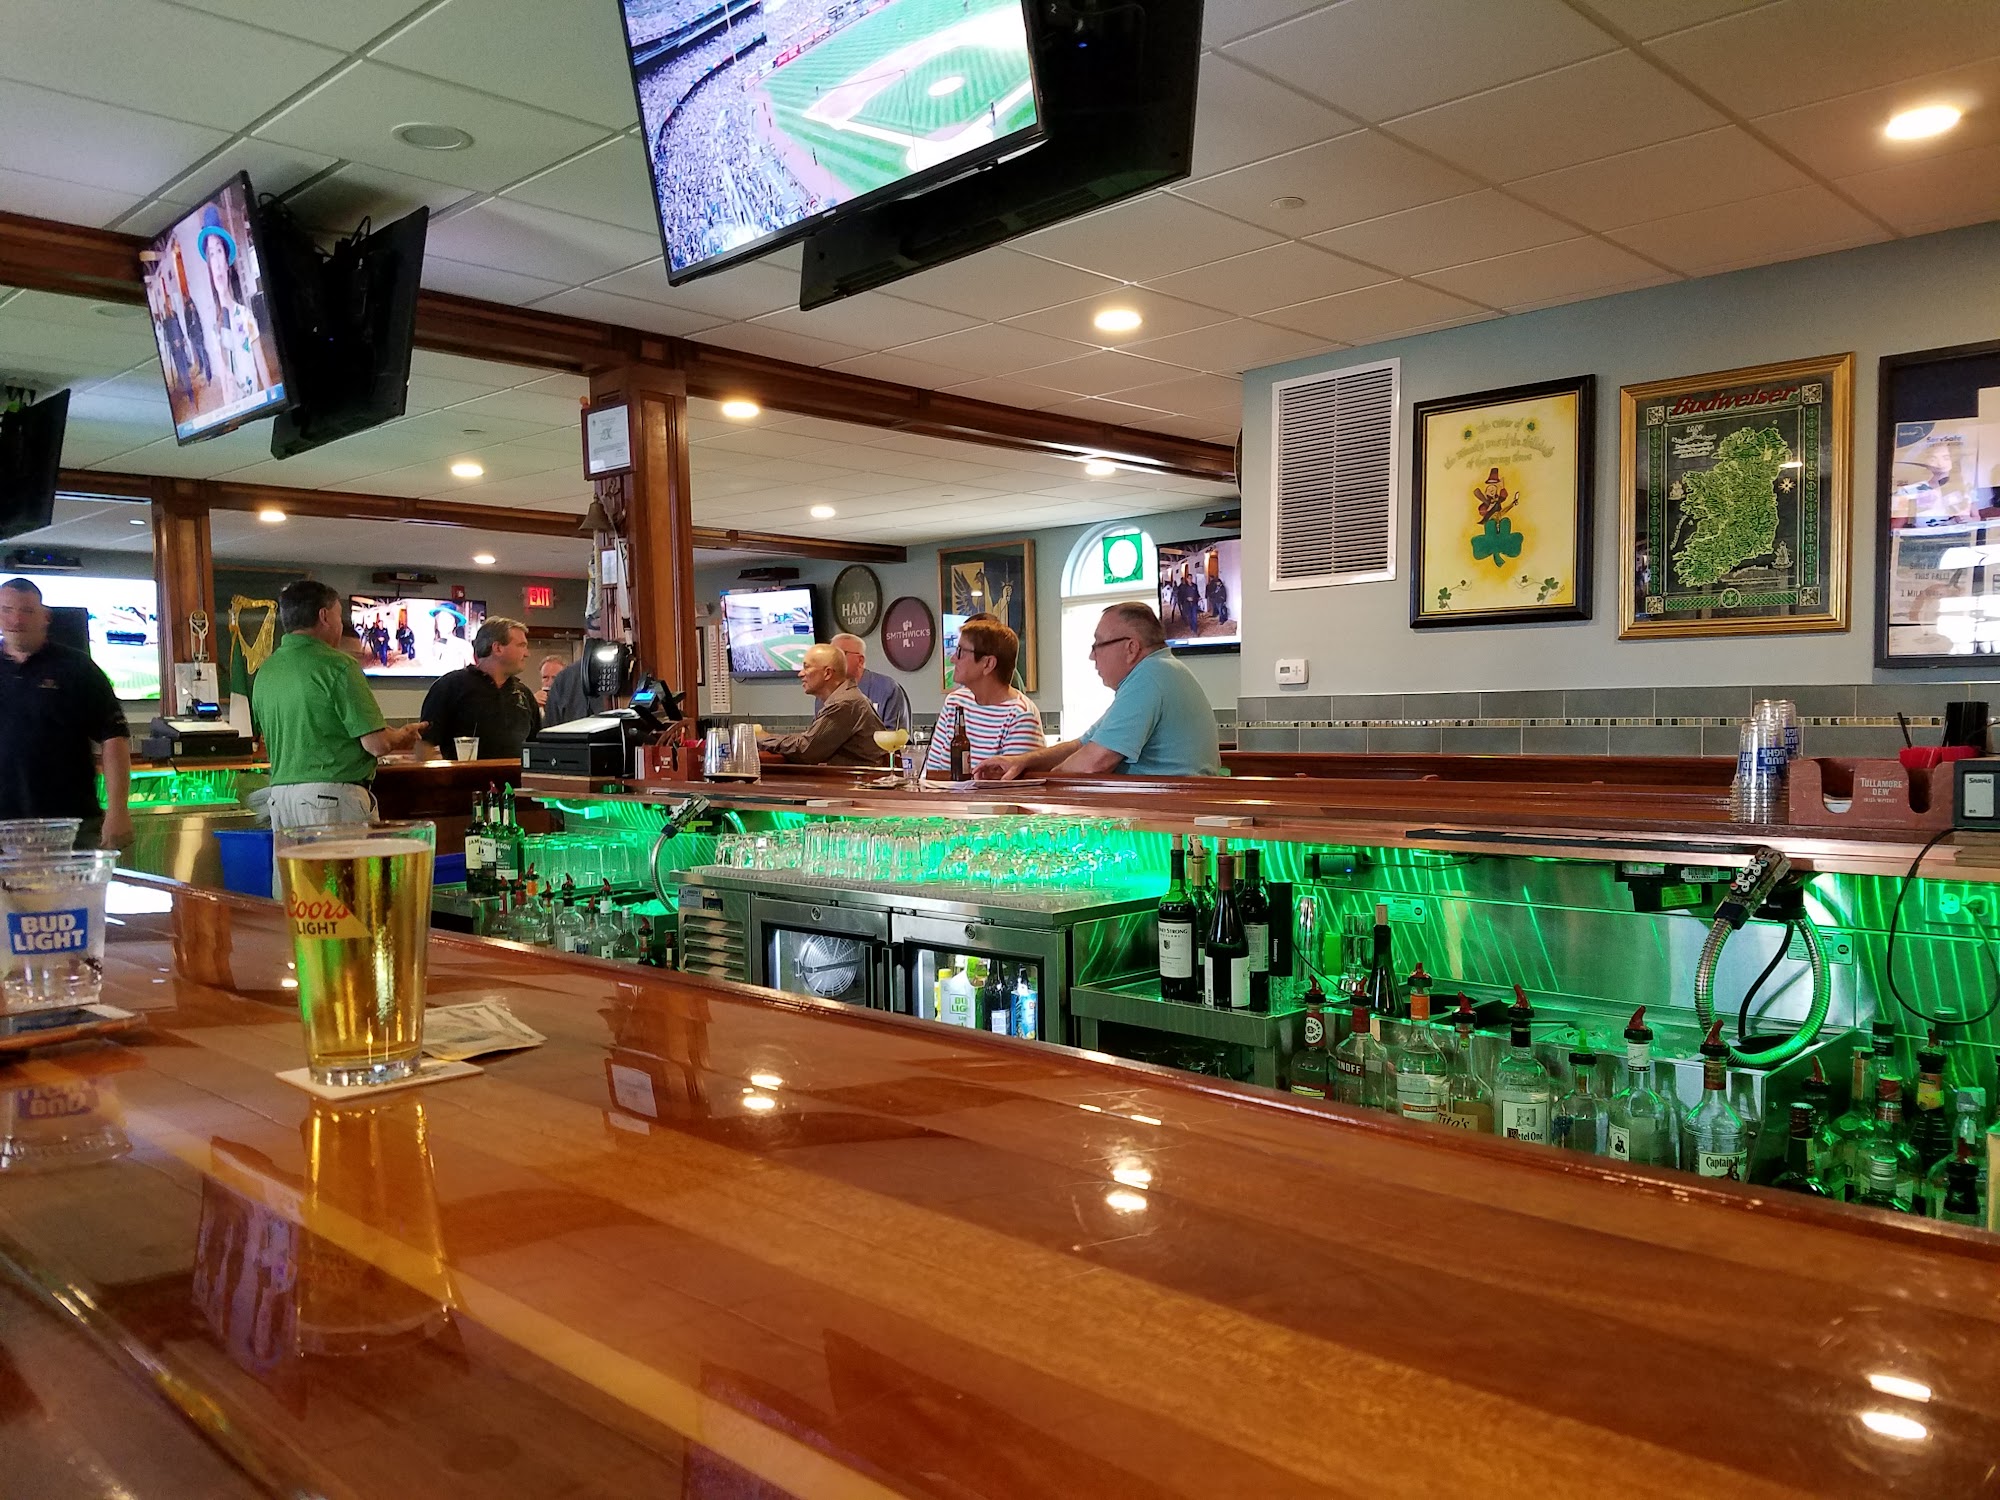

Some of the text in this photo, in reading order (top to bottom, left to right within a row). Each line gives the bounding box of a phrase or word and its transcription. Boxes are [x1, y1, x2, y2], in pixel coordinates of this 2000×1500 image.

[1671, 386, 1798, 416] Budweiser
[529, 587, 551, 607] EXIT
[841, 601, 875, 617] HARP
[847, 617, 866, 625] LAGER
[885, 628, 931, 641] SMITHWICK'S
[1763, 756, 1785, 765] BUD
[1859, 777, 1903, 788] TULLAMORE
[1872, 788, 1890, 796] DEW
[287, 890, 350, 920] Coors
[20, 913, 76, 934] BUD
[296, 921, 338, 935] LIGHT
[1166, 927, 1188, 935] STRONG
[13, 930, 85, 951] LIGHT
[1705, 1156, 1732, 1170] Captain
